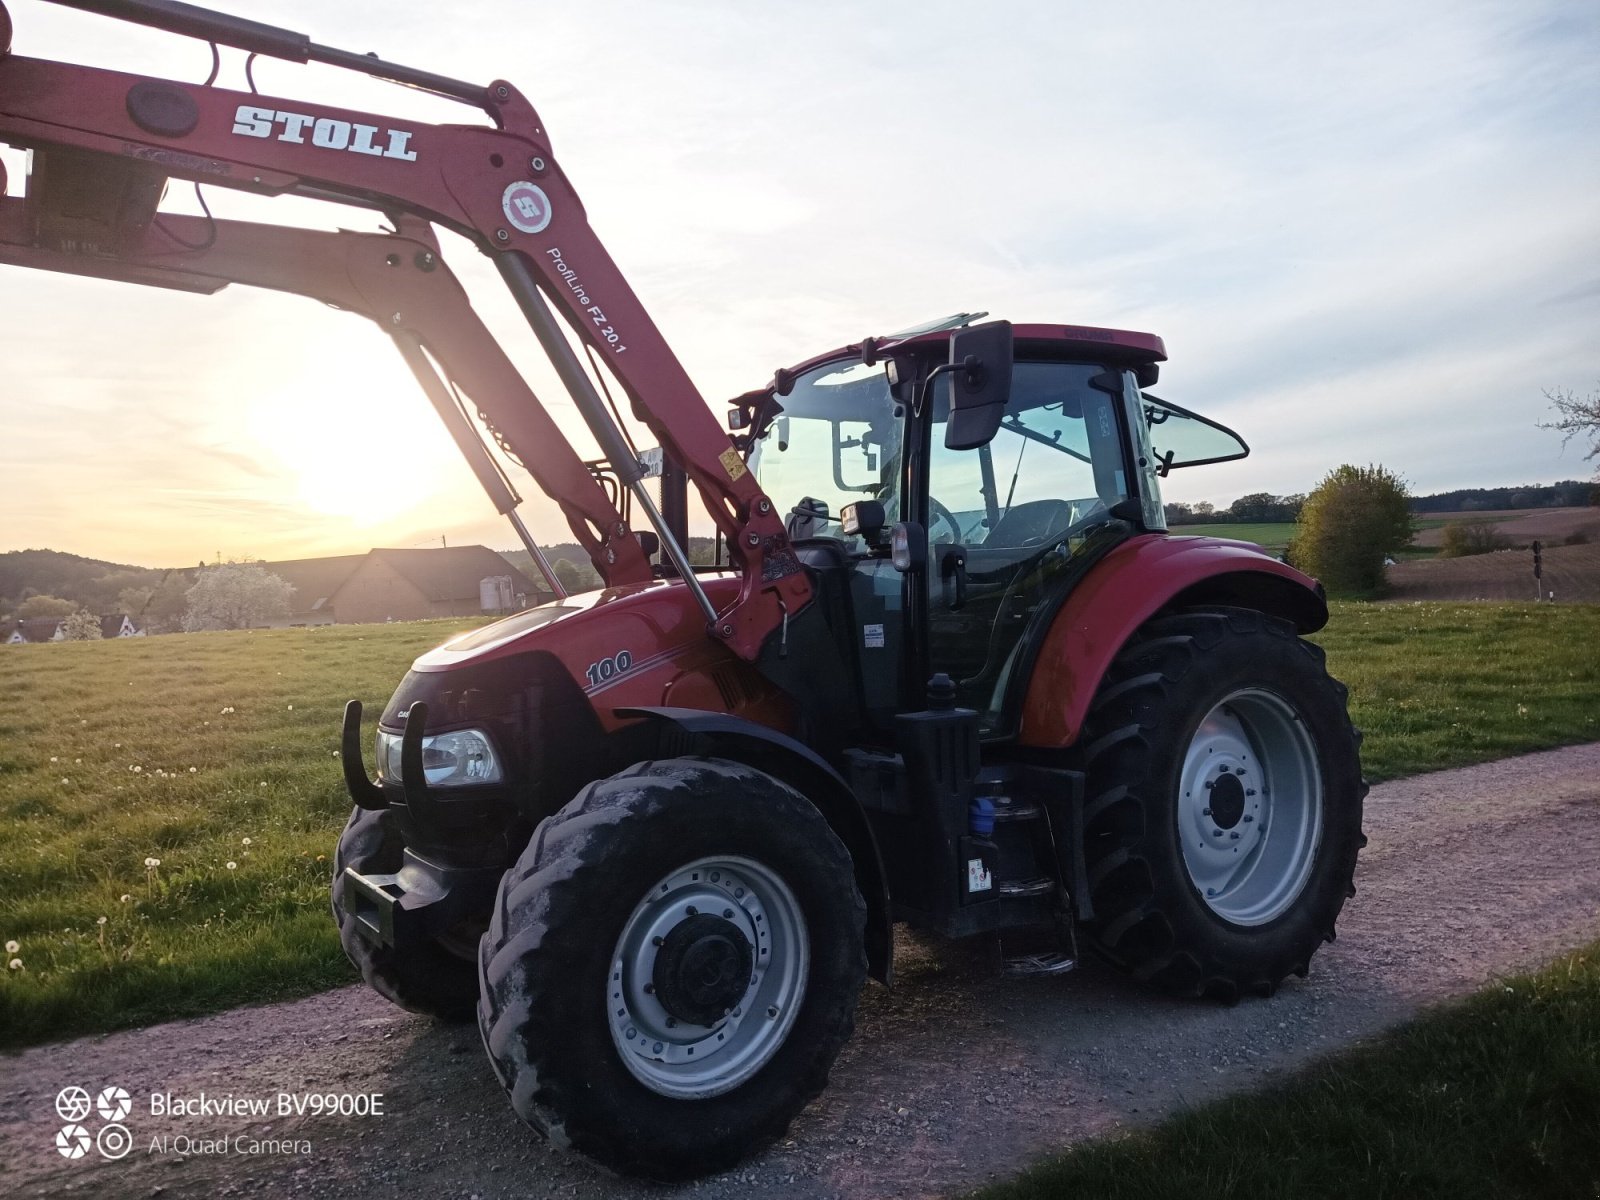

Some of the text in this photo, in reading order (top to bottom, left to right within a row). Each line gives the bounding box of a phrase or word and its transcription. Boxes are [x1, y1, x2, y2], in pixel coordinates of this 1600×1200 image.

[232, 105, 418, 162] STOLL
[546, 247, 627, 353] ProfiLine FZ 20.1
[586, 650, 632, 686] 100
